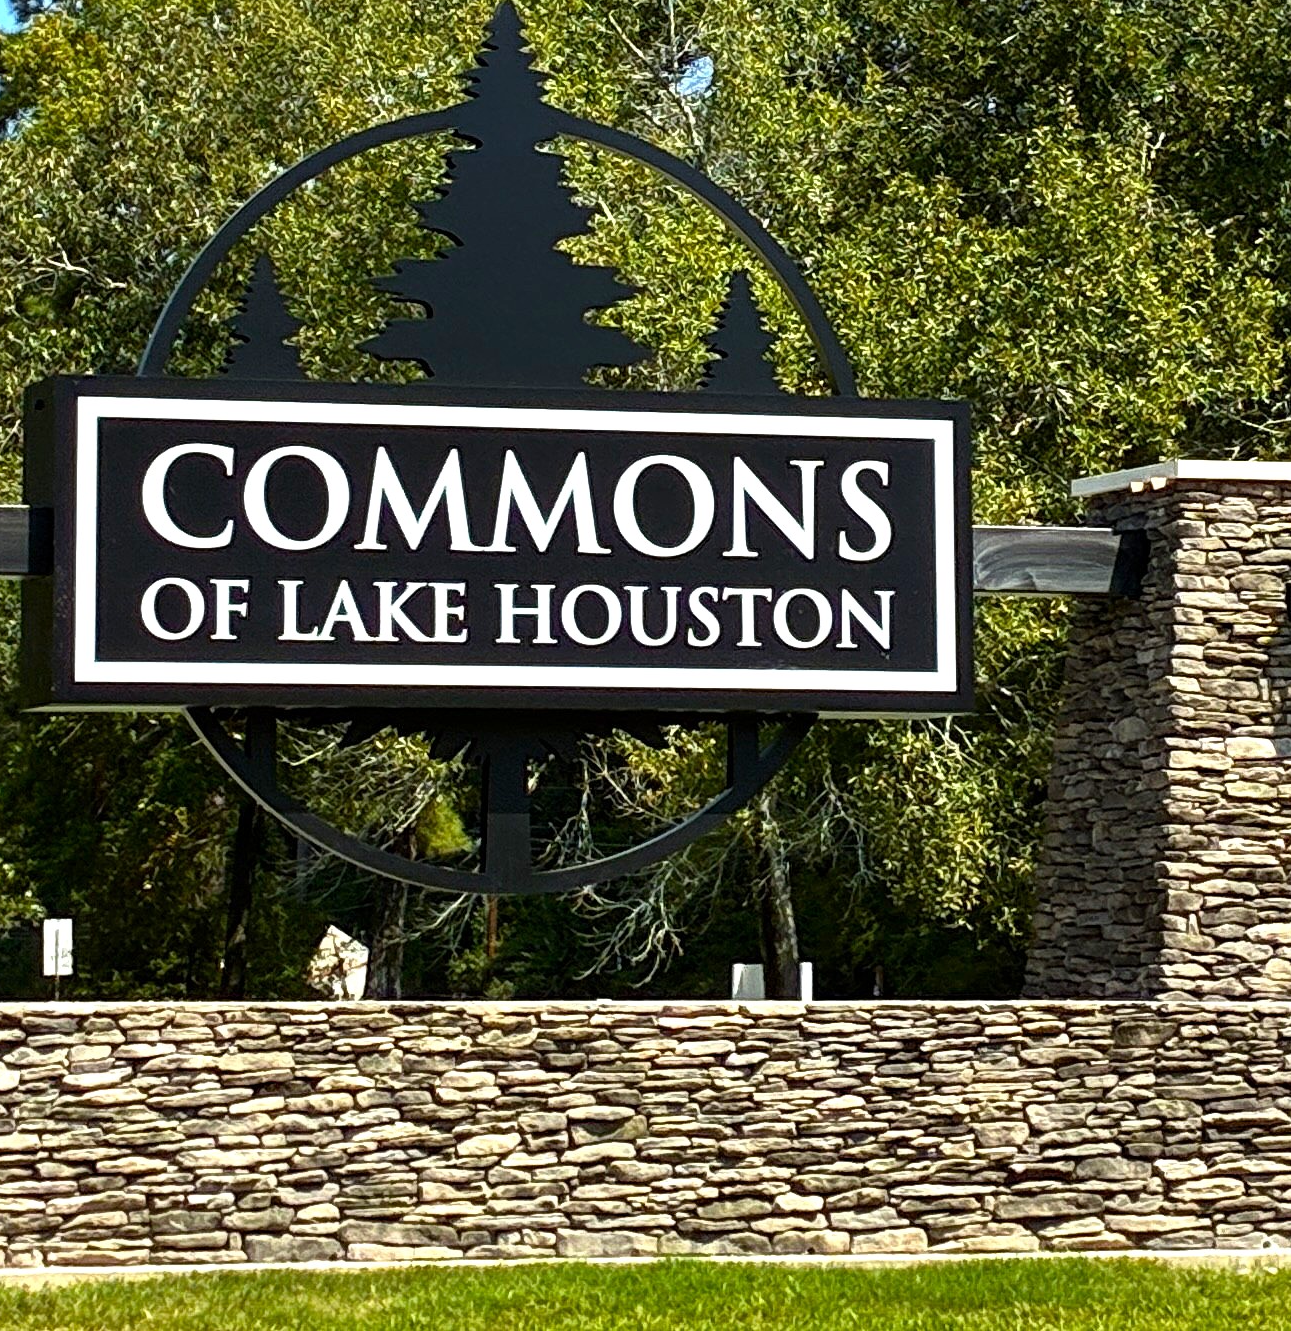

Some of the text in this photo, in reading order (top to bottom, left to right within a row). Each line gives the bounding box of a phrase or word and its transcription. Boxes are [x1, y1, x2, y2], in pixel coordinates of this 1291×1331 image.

[141, 442, 894, 562] COMMONS
[140, 577, 896, 650] OF LAKE HOUSTON
